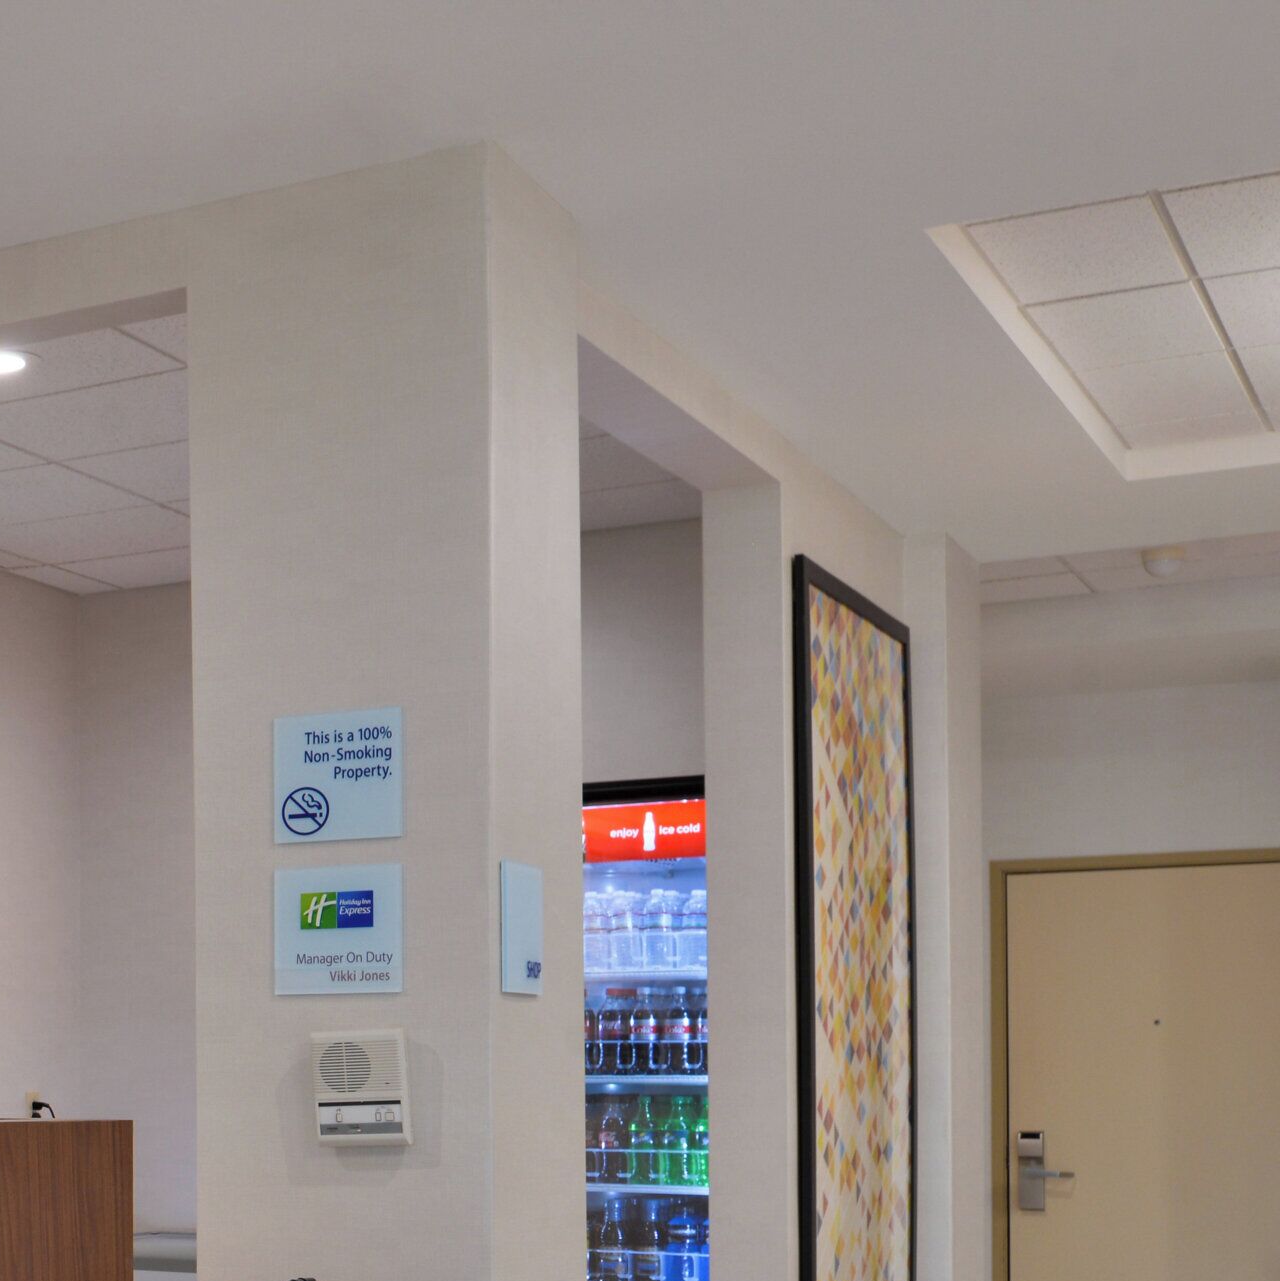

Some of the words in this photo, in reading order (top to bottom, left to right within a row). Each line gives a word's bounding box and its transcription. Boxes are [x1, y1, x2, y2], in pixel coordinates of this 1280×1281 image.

[304, 731, 330, 745] This
[334, 730, 343, 743] is
[347, 731, 354, 742] a
[358, 726, 393, 741] 100%
[304, 744, 393, 763] Non-Smoking
[333, 764, 393, 781] Property.
[609, 827, 639, 839] enjoy
[659, 825, 675, 835] ice
[676, 823, 700, 834] cold
[339, 906, 372, 916] Express
[296, 953, 343, 967] Manager
[346, 951, 363, 963] On
[366, 951, 393, 965] Duty
[329, 970, 357, 982] Vikki
[359, 970, 390, 981] Jones
